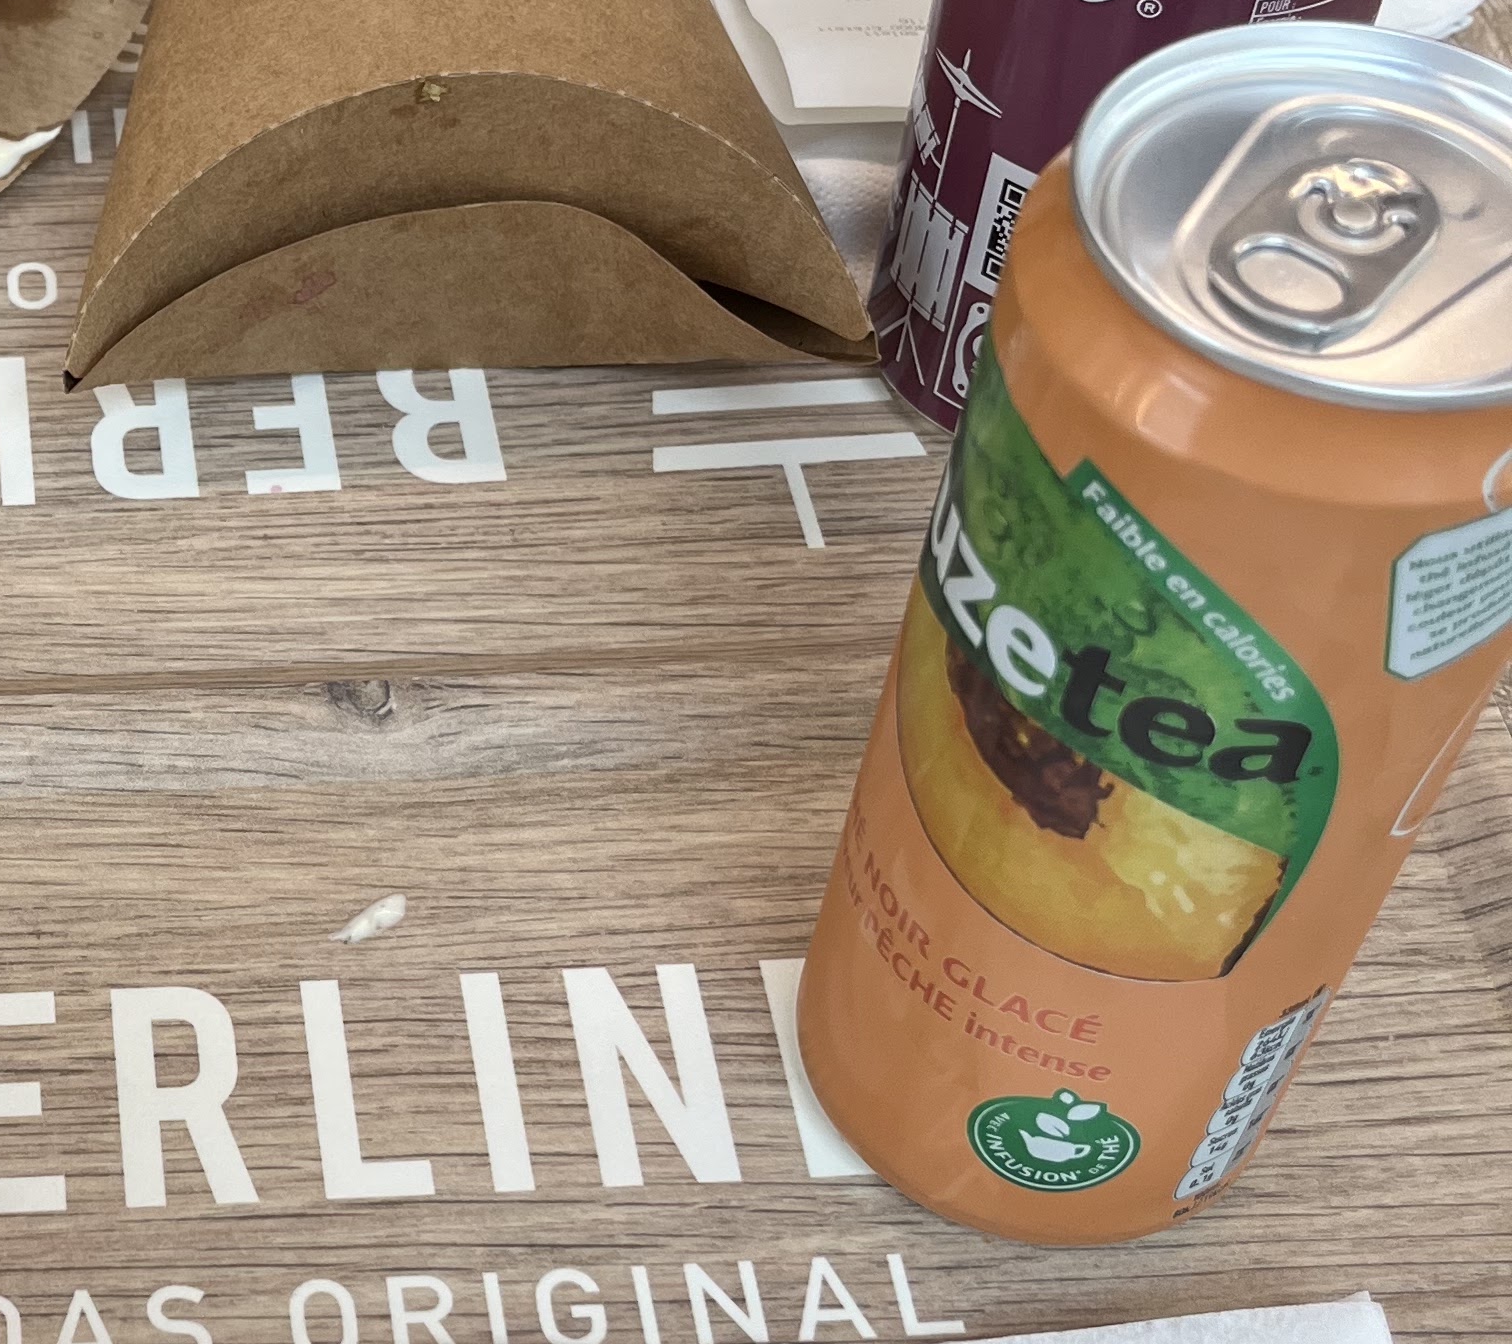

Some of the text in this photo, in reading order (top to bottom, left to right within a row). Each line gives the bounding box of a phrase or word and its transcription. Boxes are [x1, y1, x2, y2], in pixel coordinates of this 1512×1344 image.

[1082, 479, 1295, 704] Faible en calories
[863, 850, 931, 960] NOIR
[942, 956, 1104, 1044] GLACÉ
[864, 908, 1112, 1082] PÊCHE intense
[1094, 1134, 1121, 1161] THÉ
